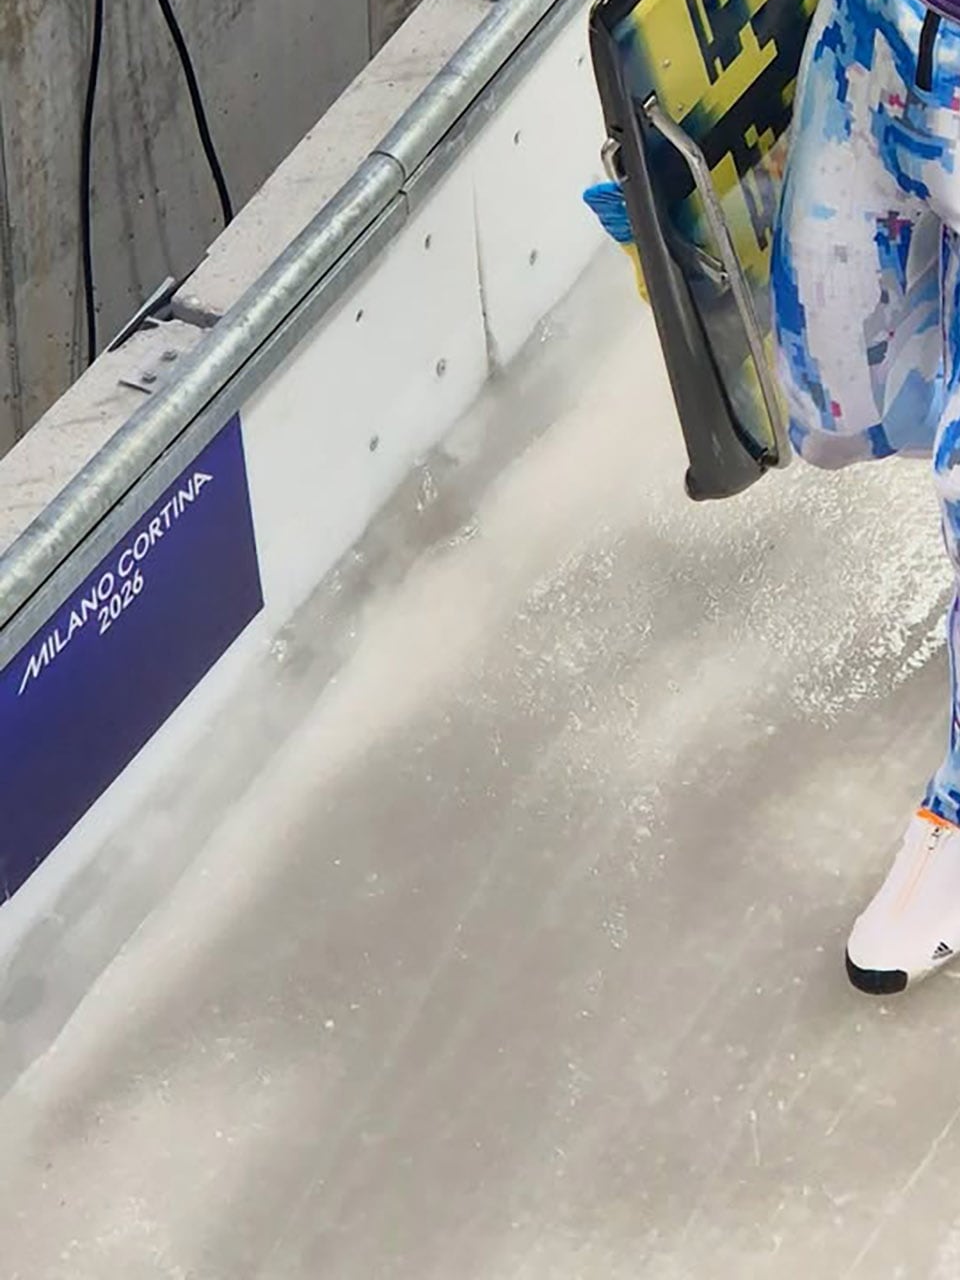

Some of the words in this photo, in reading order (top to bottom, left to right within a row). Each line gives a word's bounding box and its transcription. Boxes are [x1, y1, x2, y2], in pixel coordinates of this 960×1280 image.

[17, 571, 114, 696] MILANO
[118, 470, 213, 577] CORTINA
[98, 568, 145, 636] 2026
